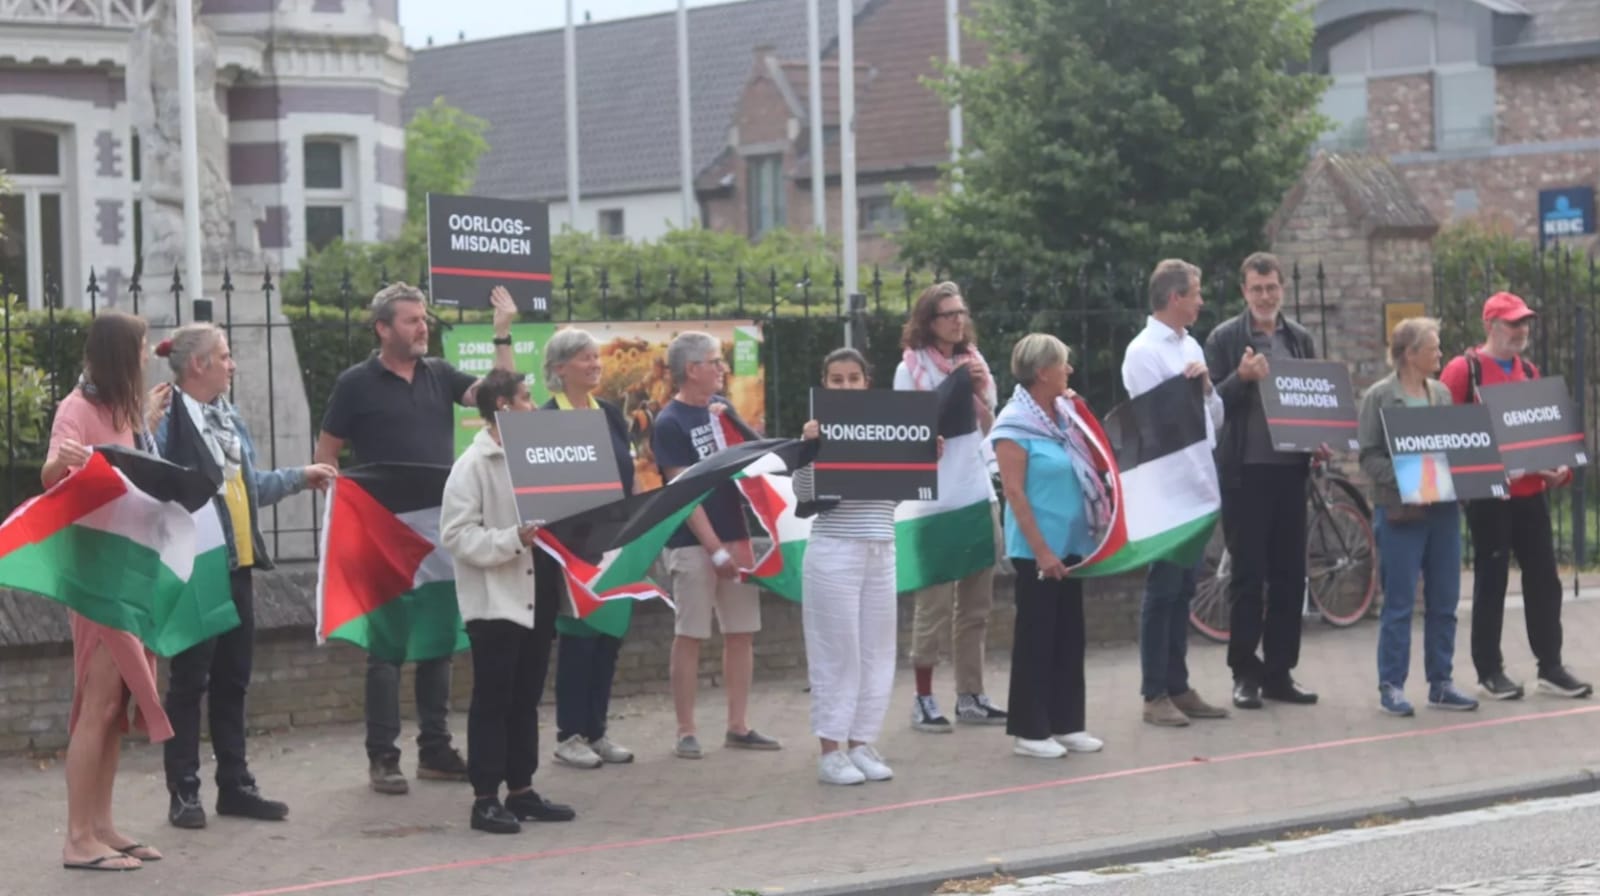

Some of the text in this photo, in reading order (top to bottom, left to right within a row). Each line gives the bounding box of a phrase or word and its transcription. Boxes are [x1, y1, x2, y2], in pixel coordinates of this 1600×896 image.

[448, 214, 532, 235] OORLOGS-
[451, 234, 531, 255] MISDADEN
[458, 342, 496, 354] ZOND
[1275, 376, 1336, 393] OORLOGS-
[1279, 392, 1338, 408] MISDADEN
[1503, 405, 1562, 426] GENOCIDE
[820, 423, 931, 442] HONGERDOOD
[1394, 432, 1491, 451] HONGERDOOD
[525, 445, 597, 464] GENOCIDE
